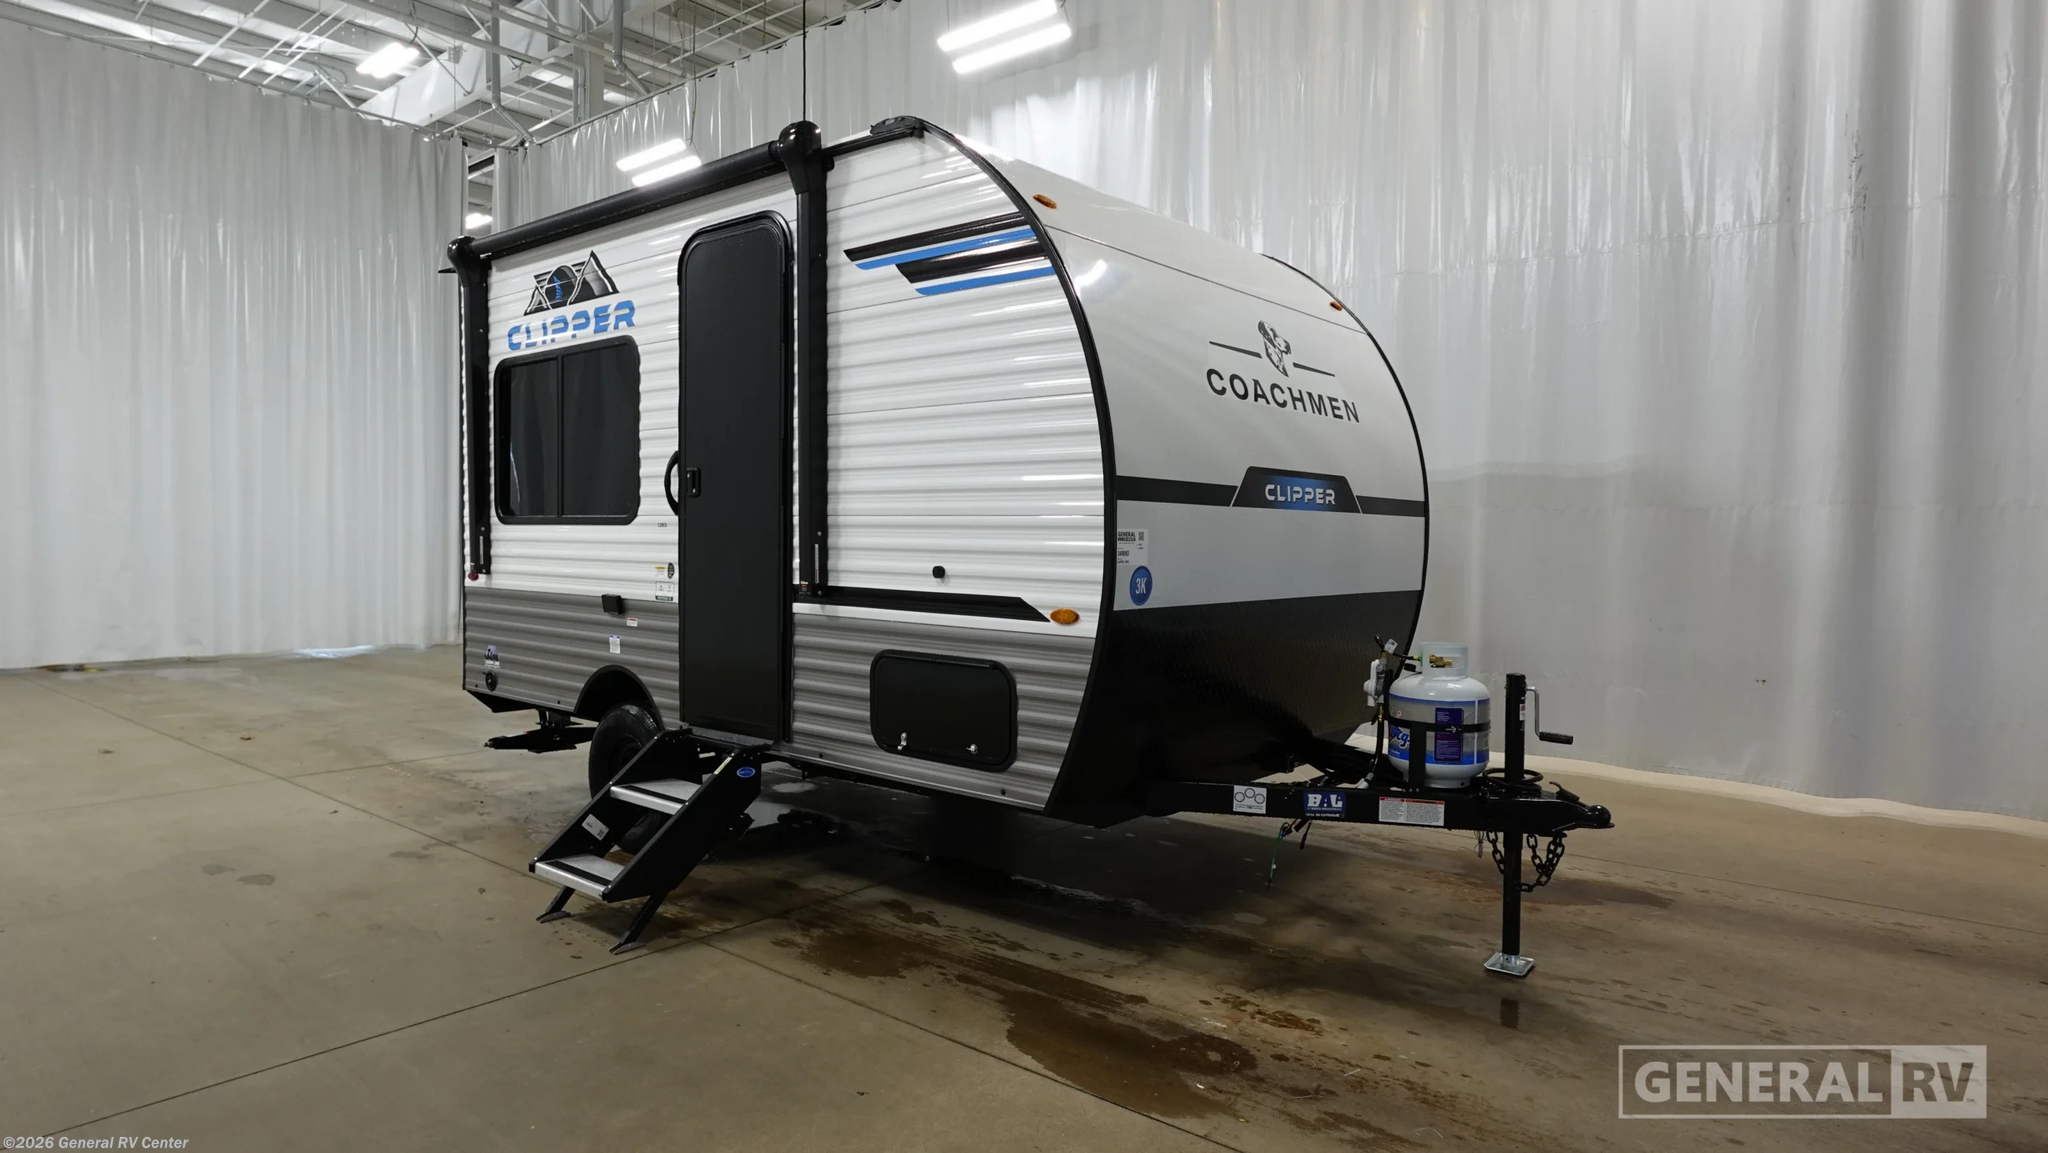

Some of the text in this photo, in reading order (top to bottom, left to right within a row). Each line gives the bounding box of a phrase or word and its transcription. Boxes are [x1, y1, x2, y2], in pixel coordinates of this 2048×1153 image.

[507, 300, 636, 351] CLIPPER
[1206, 368, 1360, 423] COACHMEN
[1264, 484, 1336, 505] CLIPPER
[1135, 577, 1147, 594] 3K
